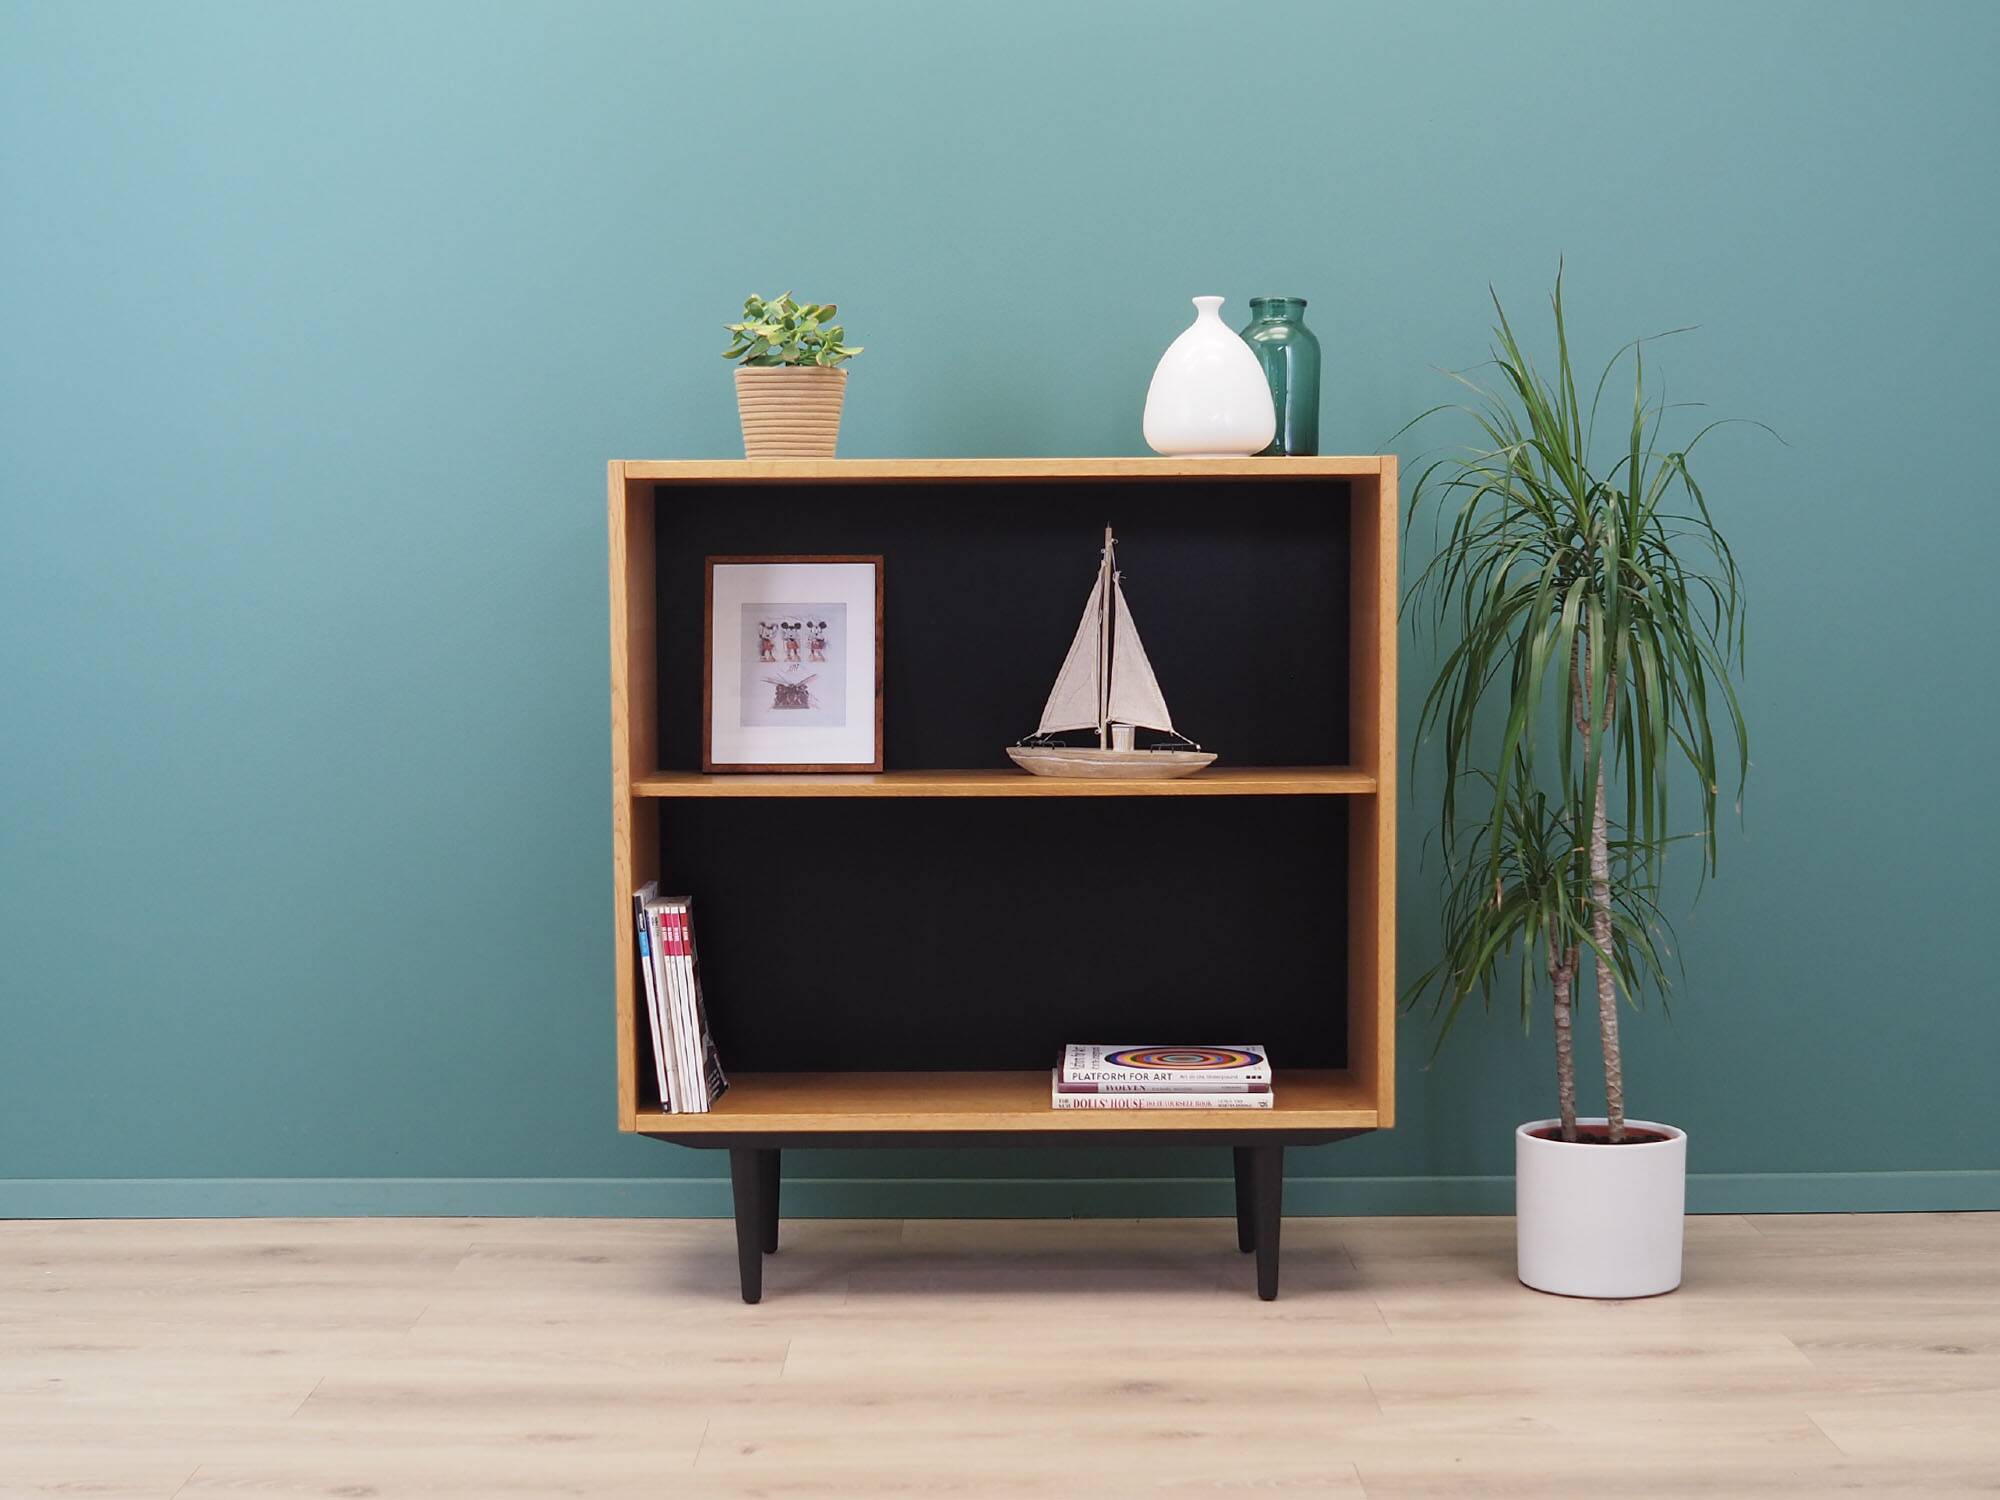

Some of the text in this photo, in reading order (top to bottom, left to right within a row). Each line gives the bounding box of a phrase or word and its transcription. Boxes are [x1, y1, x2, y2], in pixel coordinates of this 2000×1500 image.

[1072, 1072, 1173, 1081] PLATFORM FOR ART
[1110, 1099, 1144, 1108] HOUSE
